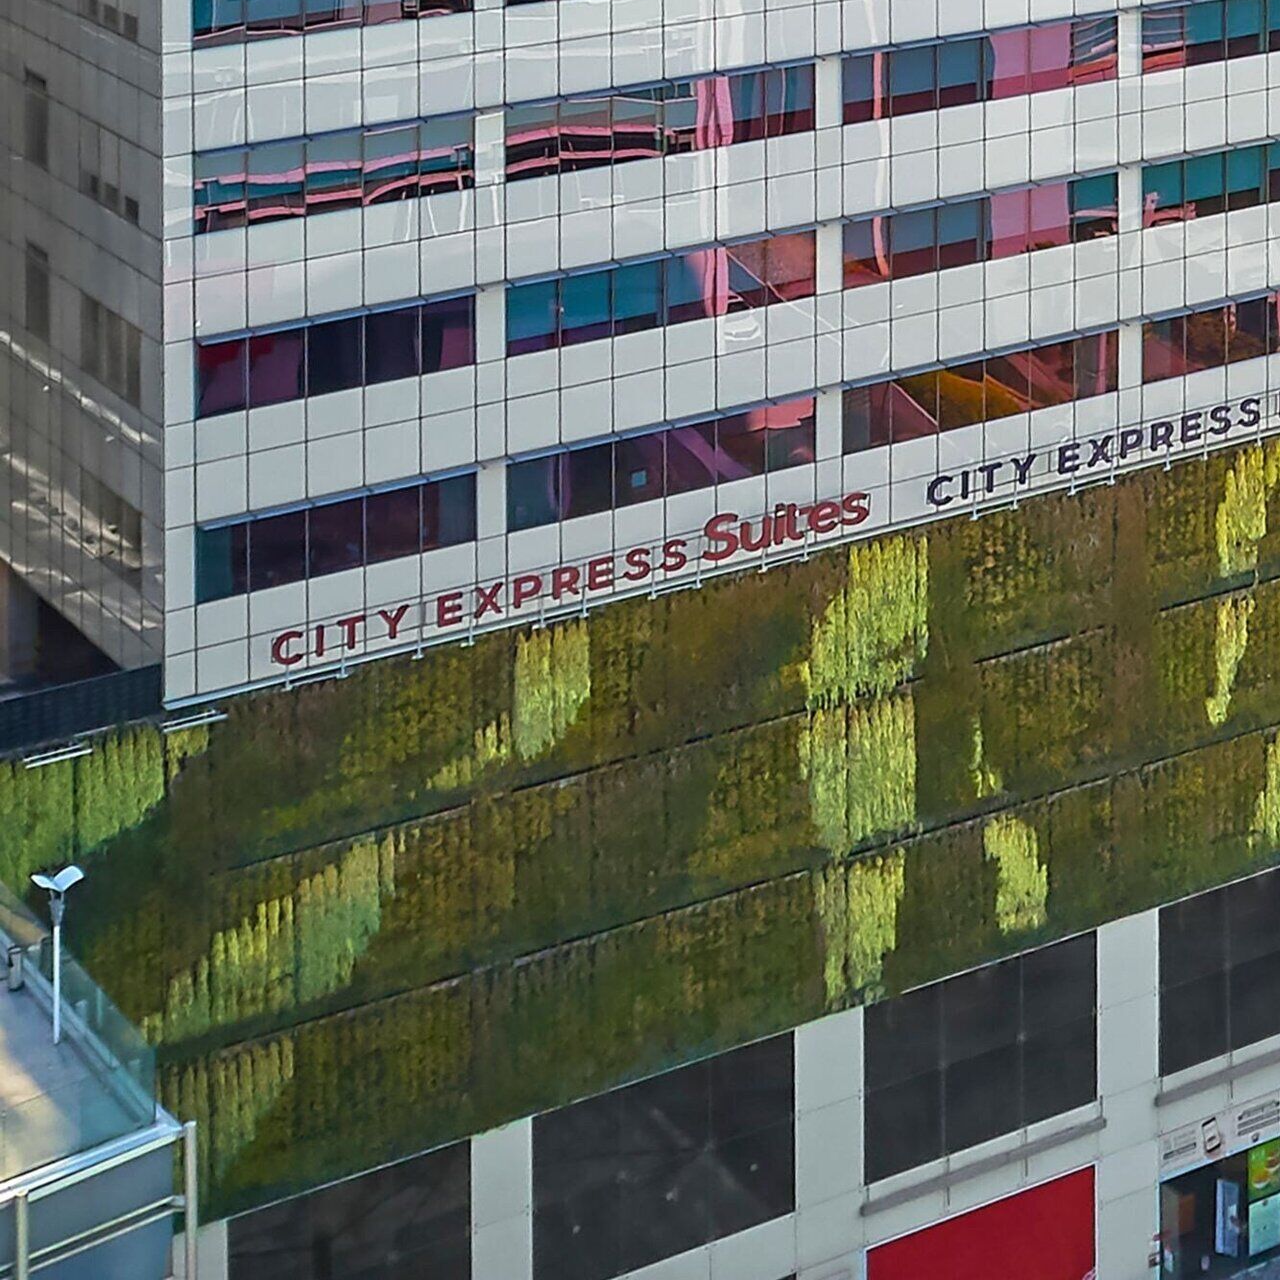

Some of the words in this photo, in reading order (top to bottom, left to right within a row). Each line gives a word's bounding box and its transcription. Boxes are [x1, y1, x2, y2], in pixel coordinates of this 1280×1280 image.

[925, 454, 1036, 506] CITY
[1057, 399, 1261, 475] EXPRESS
[272, 604, 409, 666] CITY
[436, 539, 687, 628] EXPRESS
[702, 491, 871, 561] Suites
